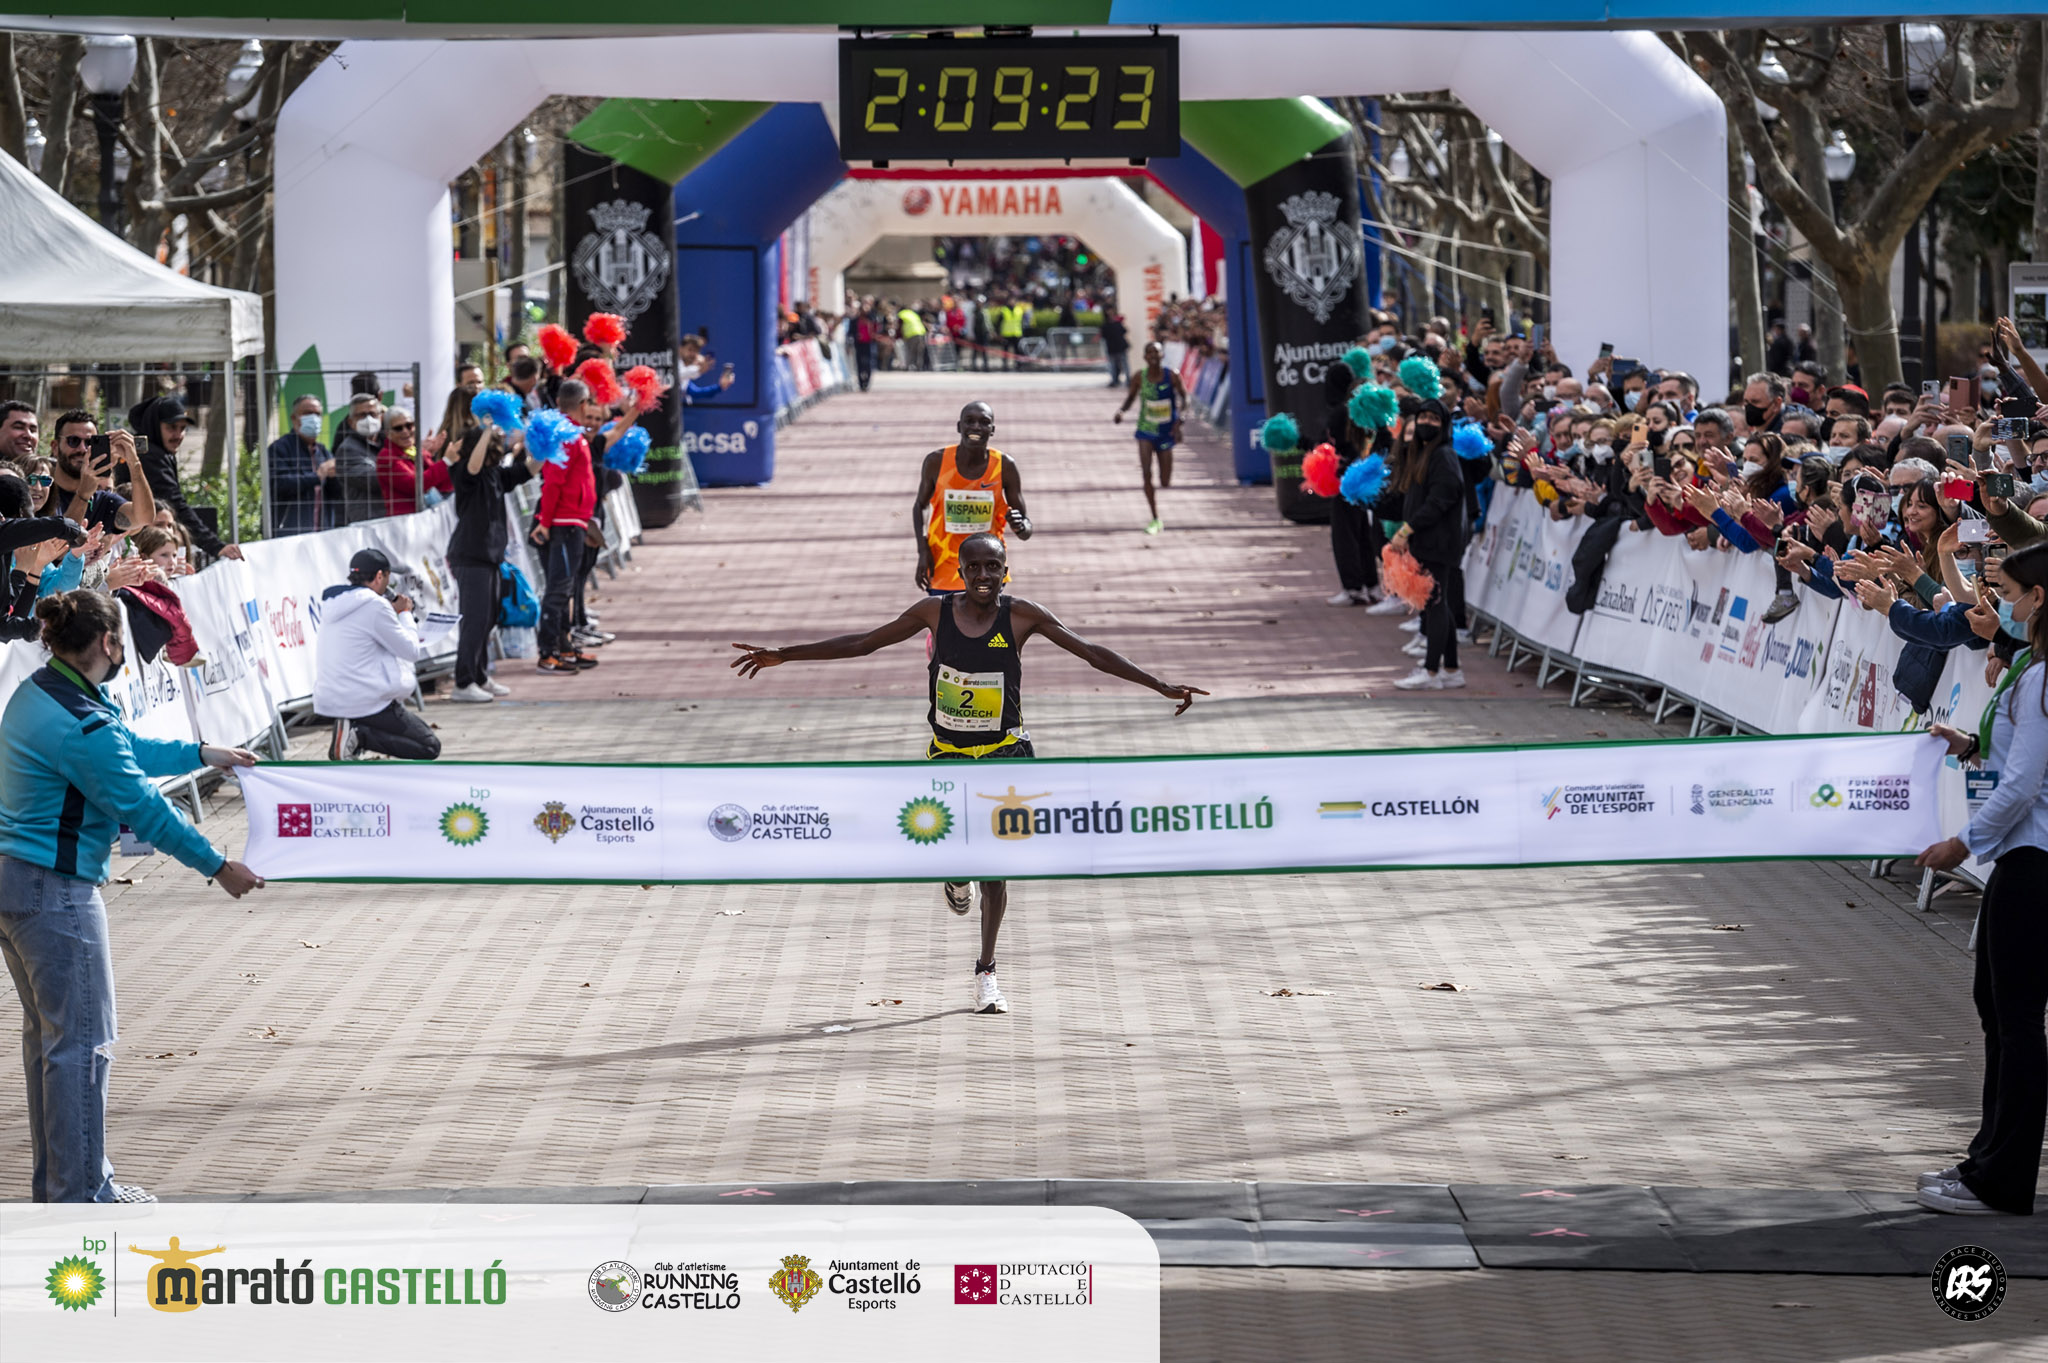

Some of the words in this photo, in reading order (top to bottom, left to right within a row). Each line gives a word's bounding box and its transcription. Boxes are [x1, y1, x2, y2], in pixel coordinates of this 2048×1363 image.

[865, 66, 1155, 132] 2:09:23
[938, 185, 1062, 216] YAMAHA
[614, 350, 673, 369] tament
[1274, 341, 1354, 368] Ajuntam
[1276, 365, 1299, 387] de
[682, 431, 747, 454] acsa
[946, 503, 991, 515] KISPANAI
[960, 690, 974, 708] 2
[942, 705, 993, 718] KIPKOECH
[931, 778, 955, 794] bp
[1605, 783, 1645, 791] Valenciana
[1847, 777, 1910, 787] FUNDACIÓN
[470, 786, 490, 801] bp
[1564, 791, 1645, 804] COMUNITAT
[1708, 788, 1775, 799] GENERALITAT
[1847, 788, 1910, 800] TRINIDAD
[313, 802, 386, 813] DIPUTACIÓ
[761, 804, 777, 812] Club
[780, 804, 819, 812] d'atletisme
[1371, 795, 1480, 817] CASTELLÓN
[1570, 804, 1589, 815] DE
[1592, 802, 1655, 814] L'ESPORT
[1709, 798, 1774, 808] VALENCIANA
[1848, 799, 1910, 811] ALFONSO
[581, 804, 637, 816] Ajuntament
[641, 805, 654, 815] de
[998, 800, 1124, 835] marató
[1130, 796, 1274, 833] CASTELLÓ
[313, 816, 324, 825] D
[378, 816, 386, 825] E
[580, 815, 655, 831] Castelló
[753, 812, 830, 826] RUNNING
[313, 826, 386, 838] CASTELLÓ
[596, 833, 635, 844] Esports
[752, 824, 832, 840] CASTELLÓ
